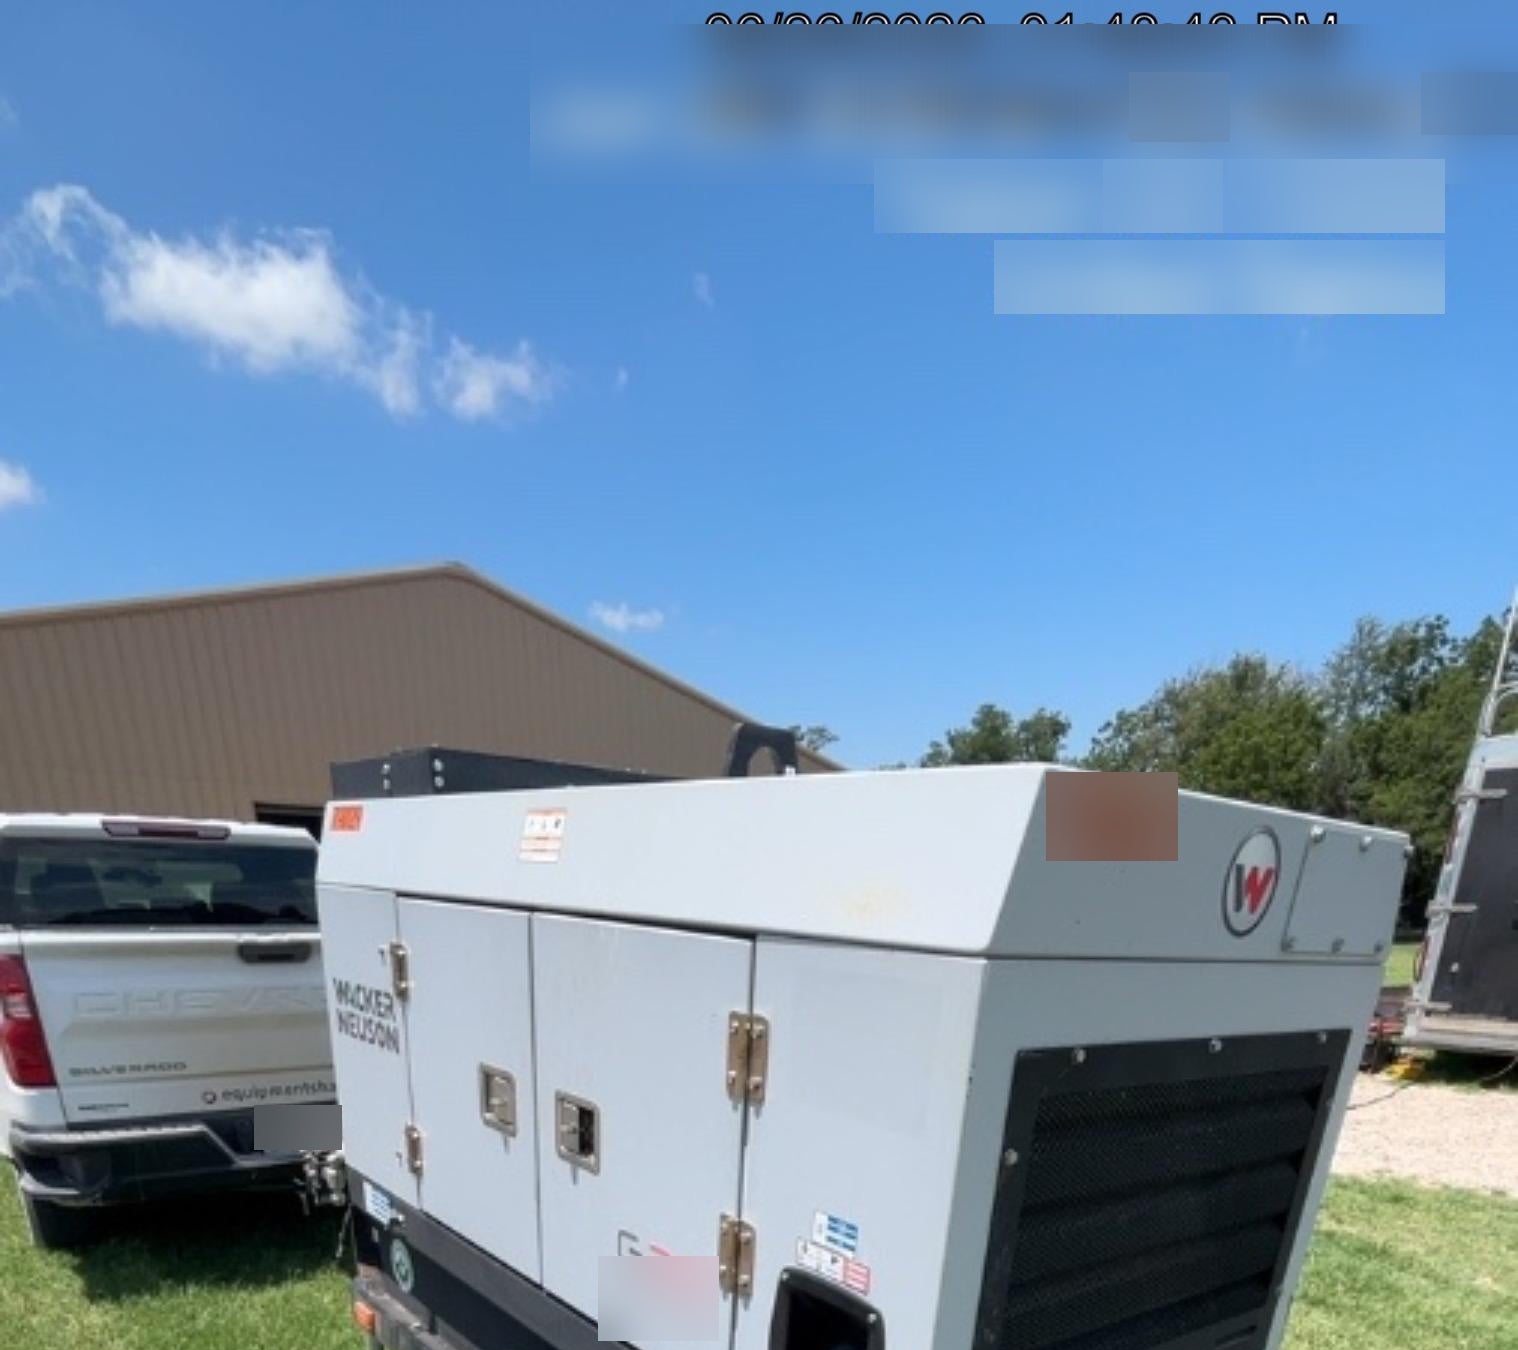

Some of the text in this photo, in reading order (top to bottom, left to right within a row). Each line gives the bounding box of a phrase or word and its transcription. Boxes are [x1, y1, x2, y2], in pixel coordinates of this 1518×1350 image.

[333, 977, 396, 1021] WACKER
[336, 1008, 399, 1054] NEUSON
[69, 1062, 187, 1077] SILVERADO
